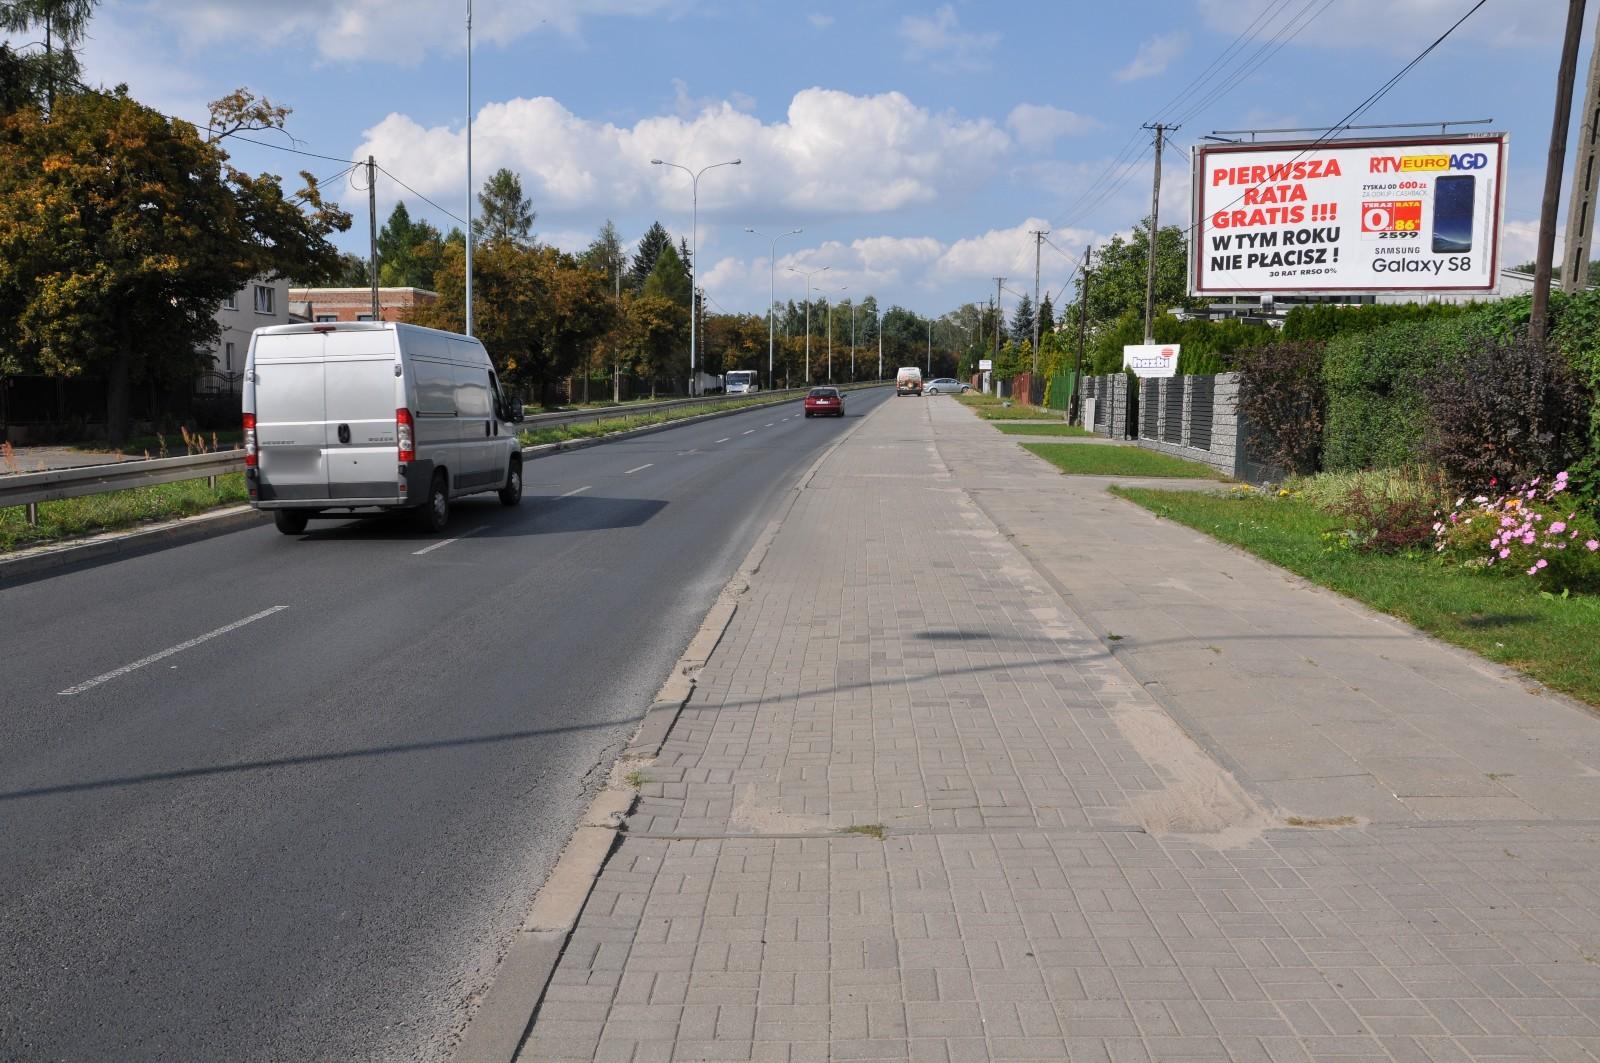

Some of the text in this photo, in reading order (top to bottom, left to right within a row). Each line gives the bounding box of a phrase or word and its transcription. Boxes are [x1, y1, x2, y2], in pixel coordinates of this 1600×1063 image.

[1212, 159, 1342, 186] PIERWSZA
[1370, 153, 1488, 173] RTV EURO AGD
[1244, 184, 1307, 205] RATA
[1212, 203, 1337, 228] GRATIS !!!
[1364, 208, 1390, 231] 0
[1212, 227, 1340, 251] W TYM ROKU
[1211, 247, 1339, 271] NIE PŁACISZ !
[1372, 257, 1471, 275] Galaxy S8
